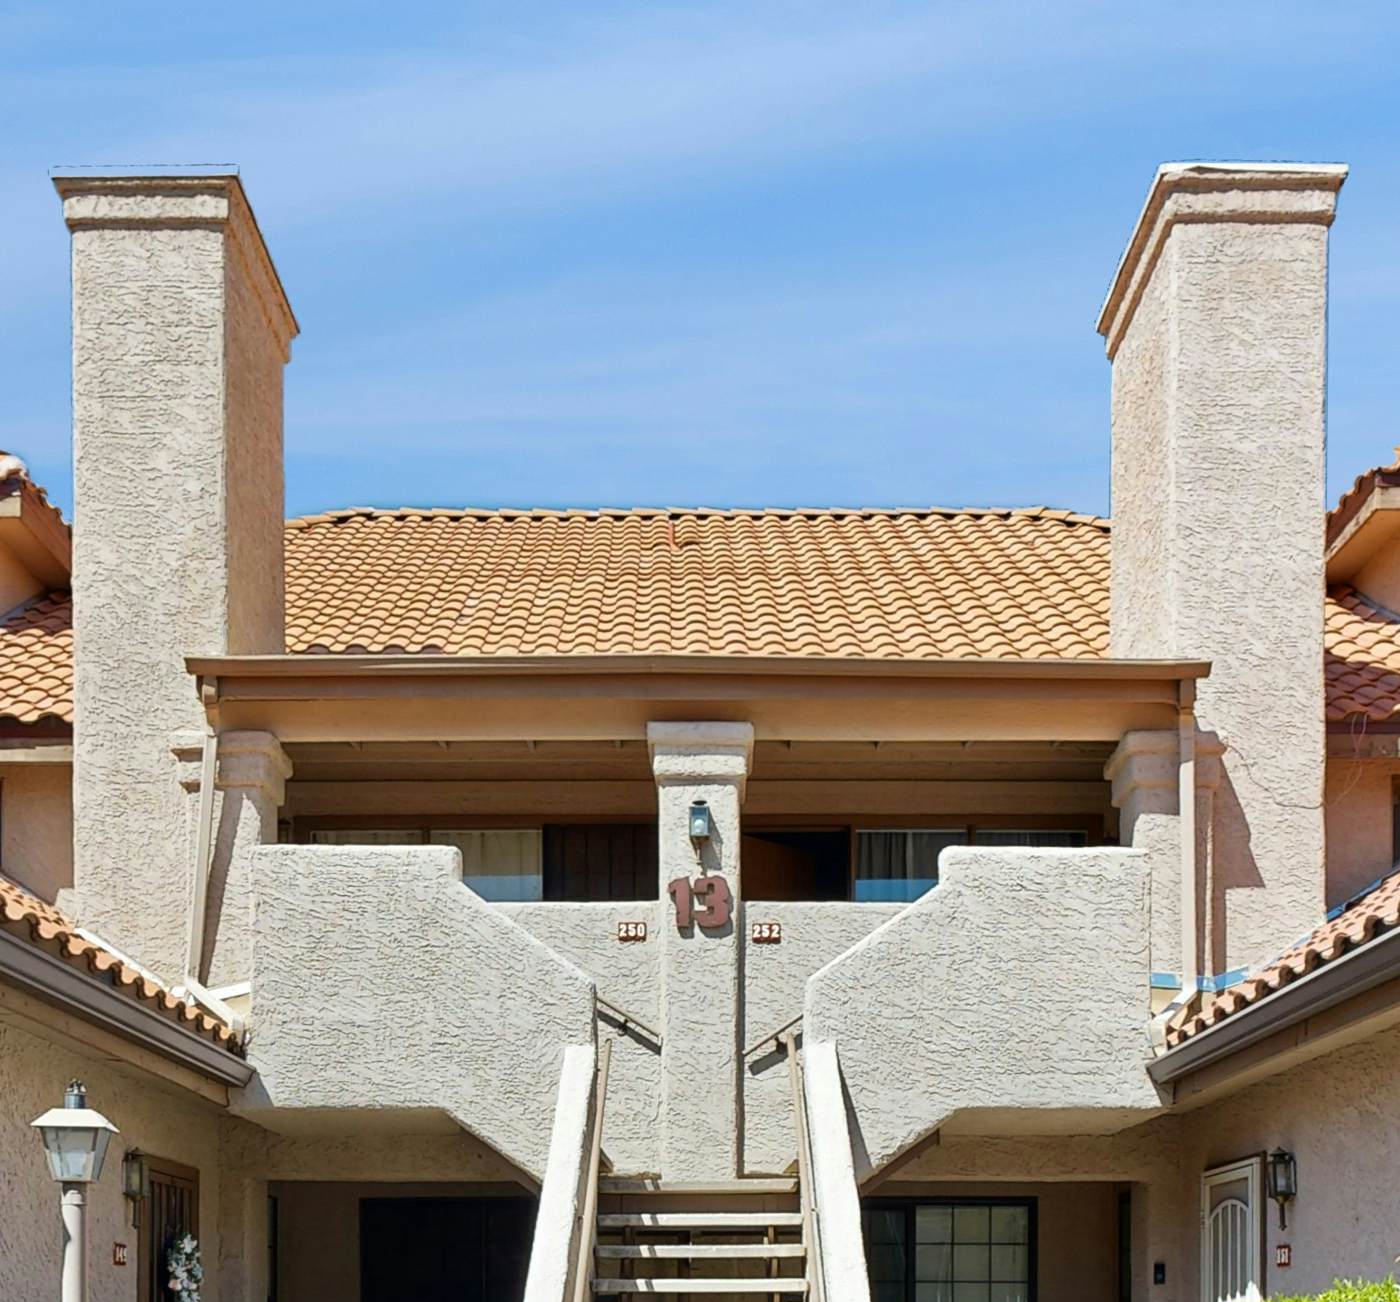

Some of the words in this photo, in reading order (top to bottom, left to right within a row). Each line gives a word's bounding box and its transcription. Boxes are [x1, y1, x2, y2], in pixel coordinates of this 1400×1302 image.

[669, 875, 730, 929] 13
[618, 923, 645, 937] 250
[752, 924, 780, 938] 252
